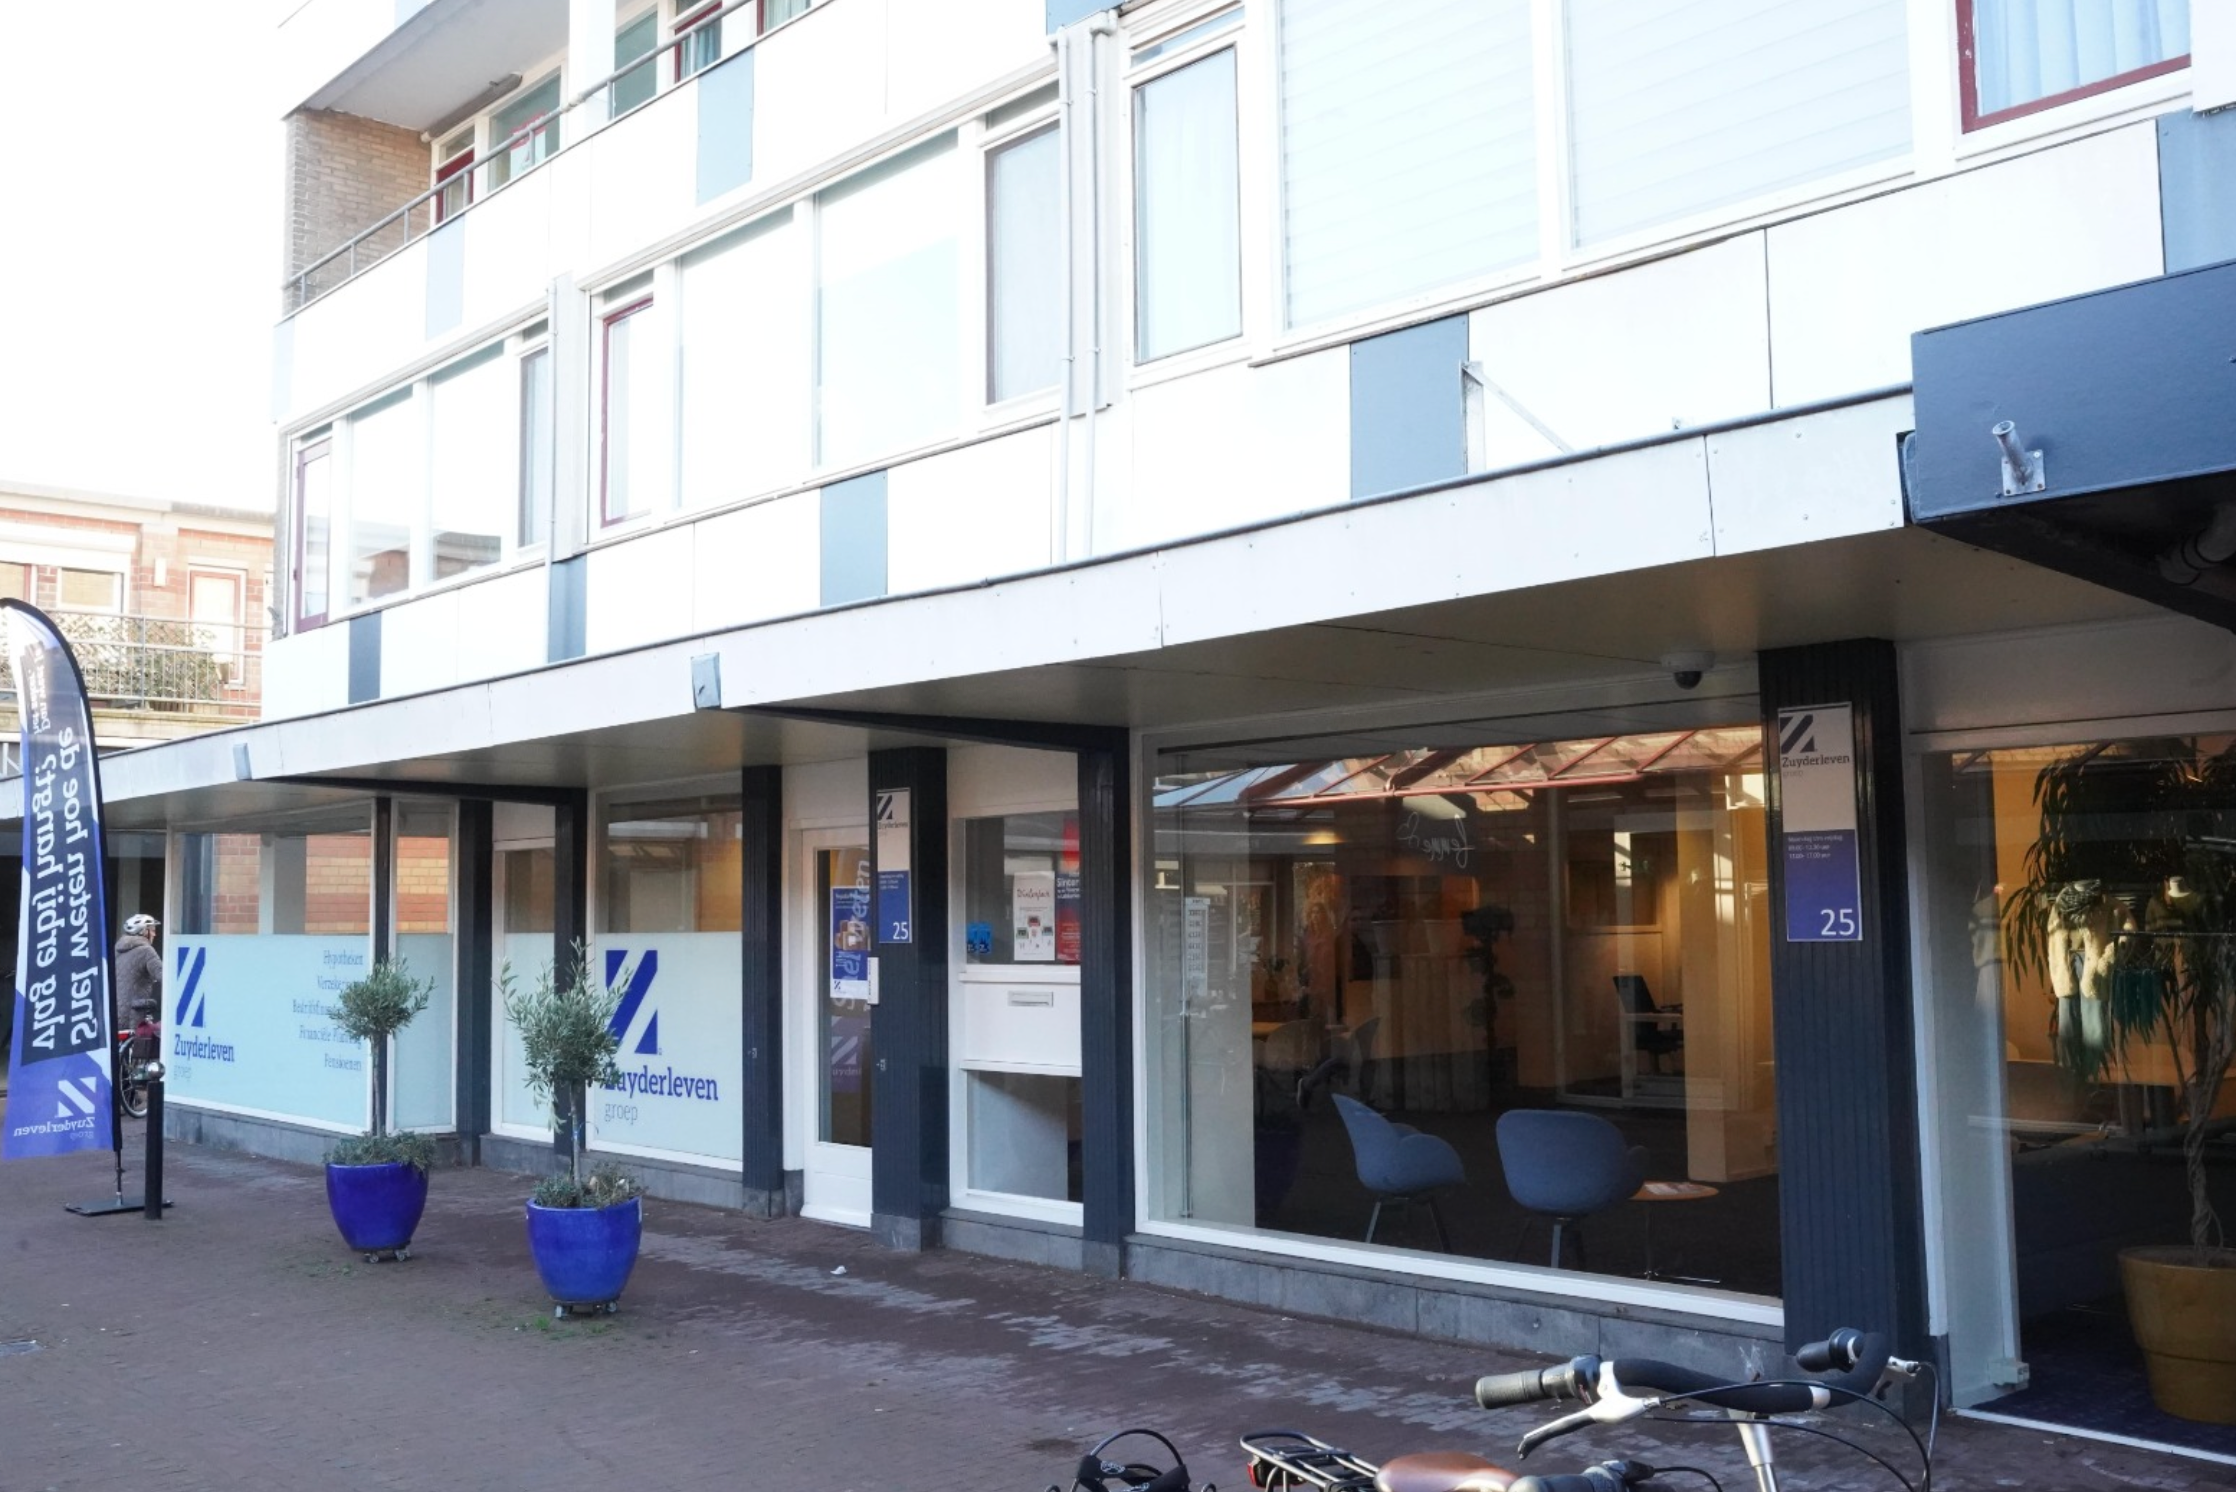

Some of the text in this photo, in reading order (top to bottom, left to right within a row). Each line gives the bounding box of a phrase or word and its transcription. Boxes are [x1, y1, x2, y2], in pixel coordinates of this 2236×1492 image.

[1781, 754, 1851, 768] Zuyderleven
[892, 921, 909, 940] 25
[1820, 908, 1856, 937] 25
[323, 949, 364, 969] Hypotheken
[174, 1033, 235, 1063] Zuyderleven
[324, 1052, 362, 1071] Pensioenen
[604, 1103, 638, 1125] groep
